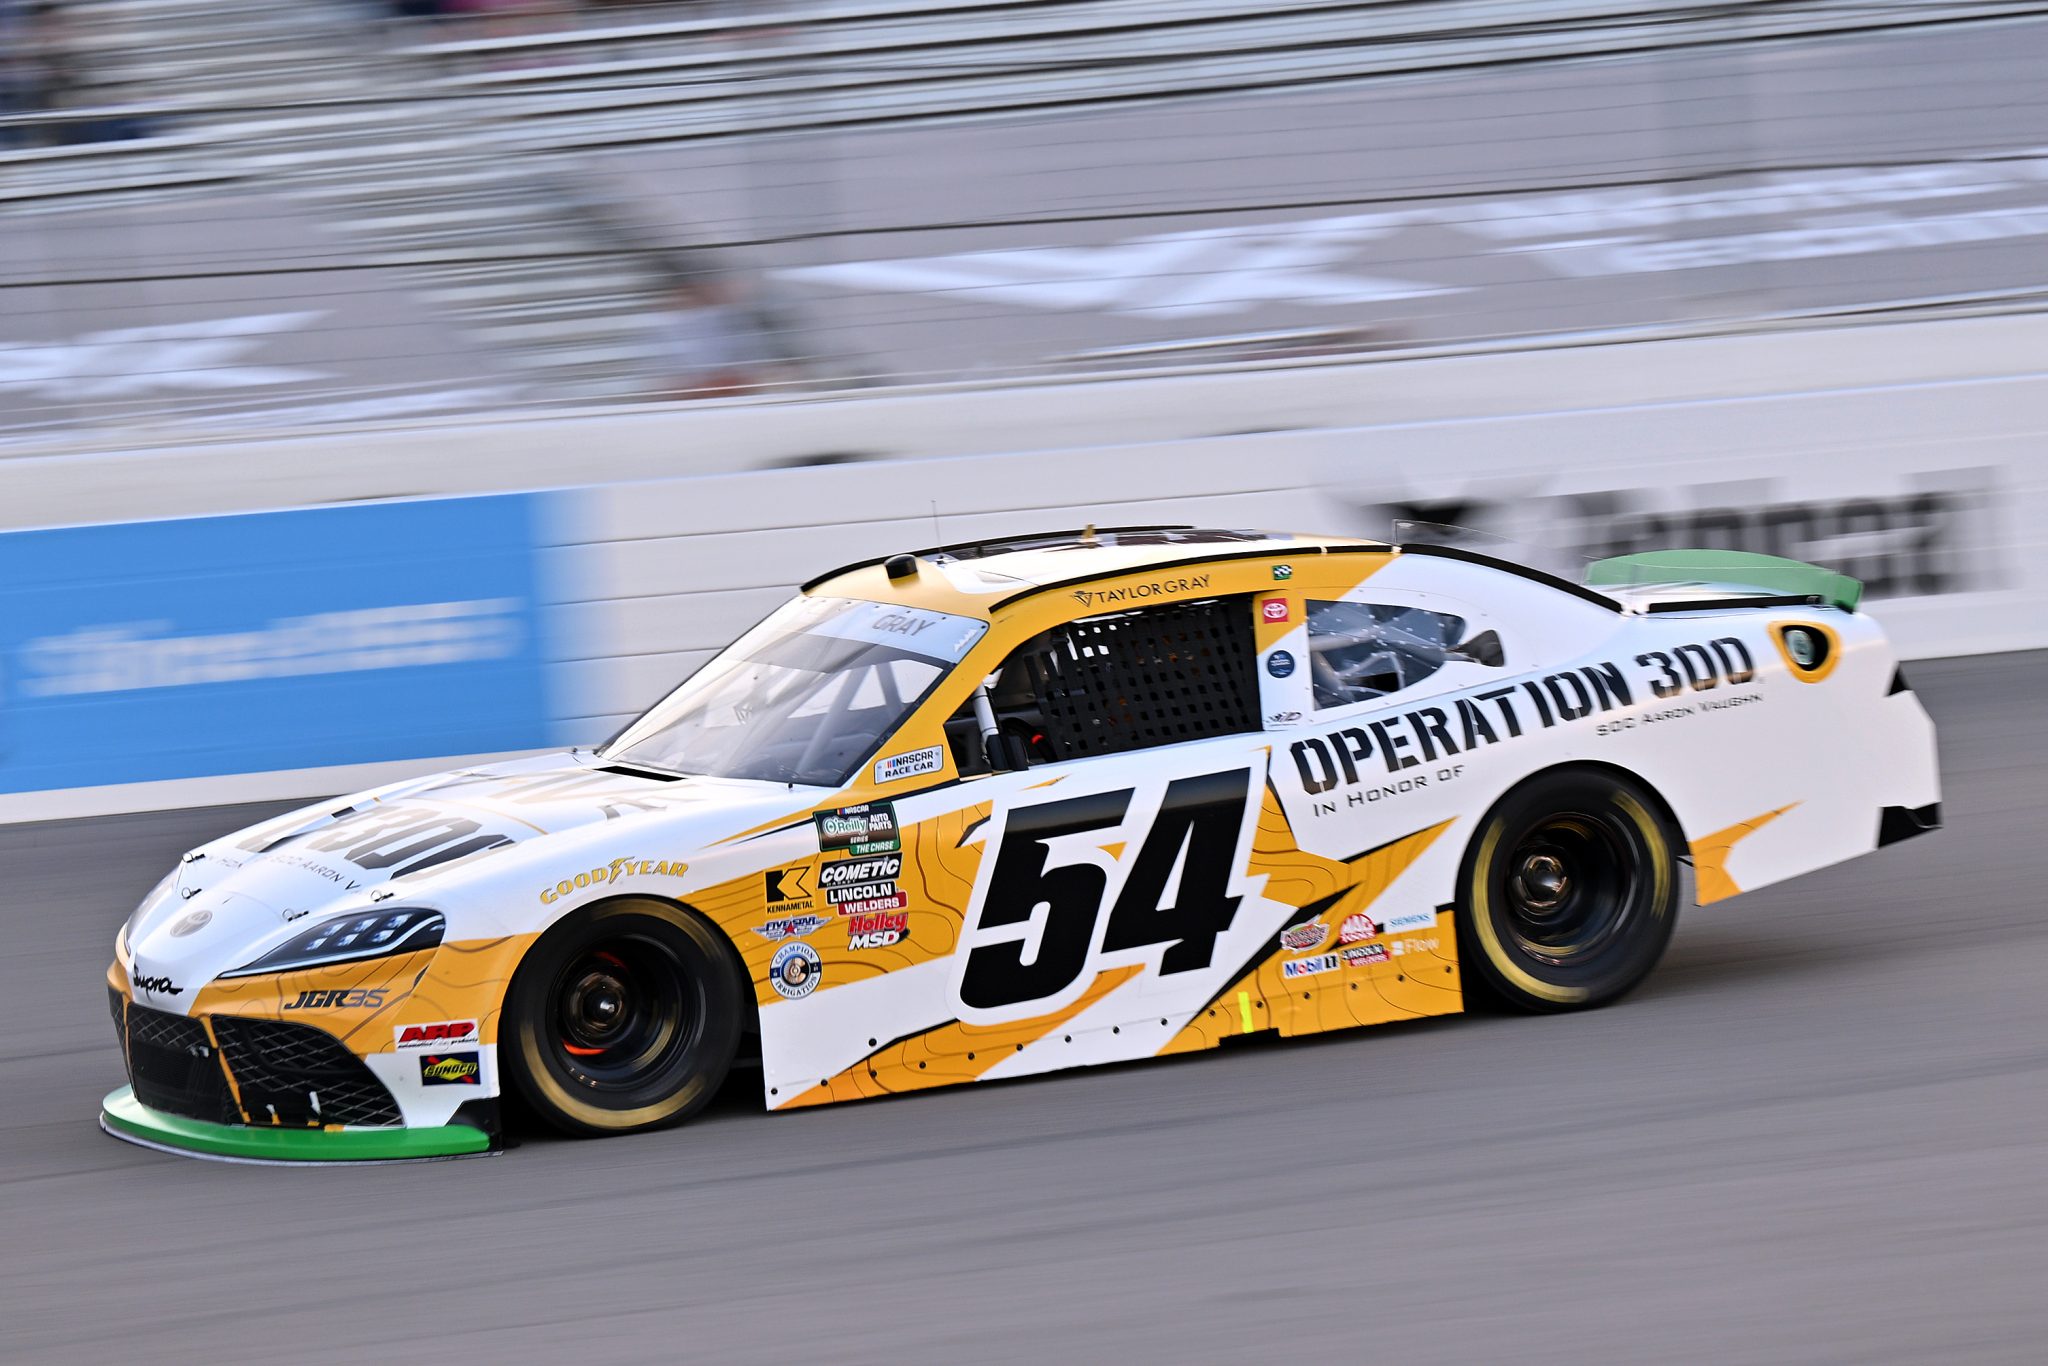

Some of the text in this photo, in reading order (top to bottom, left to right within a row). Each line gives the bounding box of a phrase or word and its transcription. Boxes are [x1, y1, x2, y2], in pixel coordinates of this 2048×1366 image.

[872, 614, 936, 636] GRAY
[1290, 636, 1756, 795] OPERATION 300
[896, 750, 934, 767] NASCAR
[885, 761, 934, 778] RACE CAR
[1314, 765, 1465, 817] IN HONOR OF
[869, 821, 892, 831] PARTS
[870, 813, 889, 822] AUTO
[856, 841, 894, 854] THE CHASE
[821, 859, 900, 884] COMETIC
[829, 883, 893, 903] LINCOLN
[960, 767, 1252, 1009] 54
[767, 901, 814, 914] KENNAMETAL
[844, 897, 900, 914] WELDERS
[848, 912, 908, 935] Holley
[847, 930, 900, 951] MSD
[775, 945, 815, 964] CHAMPION
[1285, 957, 1323, 977] Mobil
[132, 964, 184, 998] Supra
[776, 975, 817, 996] IRRIGATION
[398, 1022, 475, 1043] ARP
[423, 1062, 478, 1077] SUNOCO
